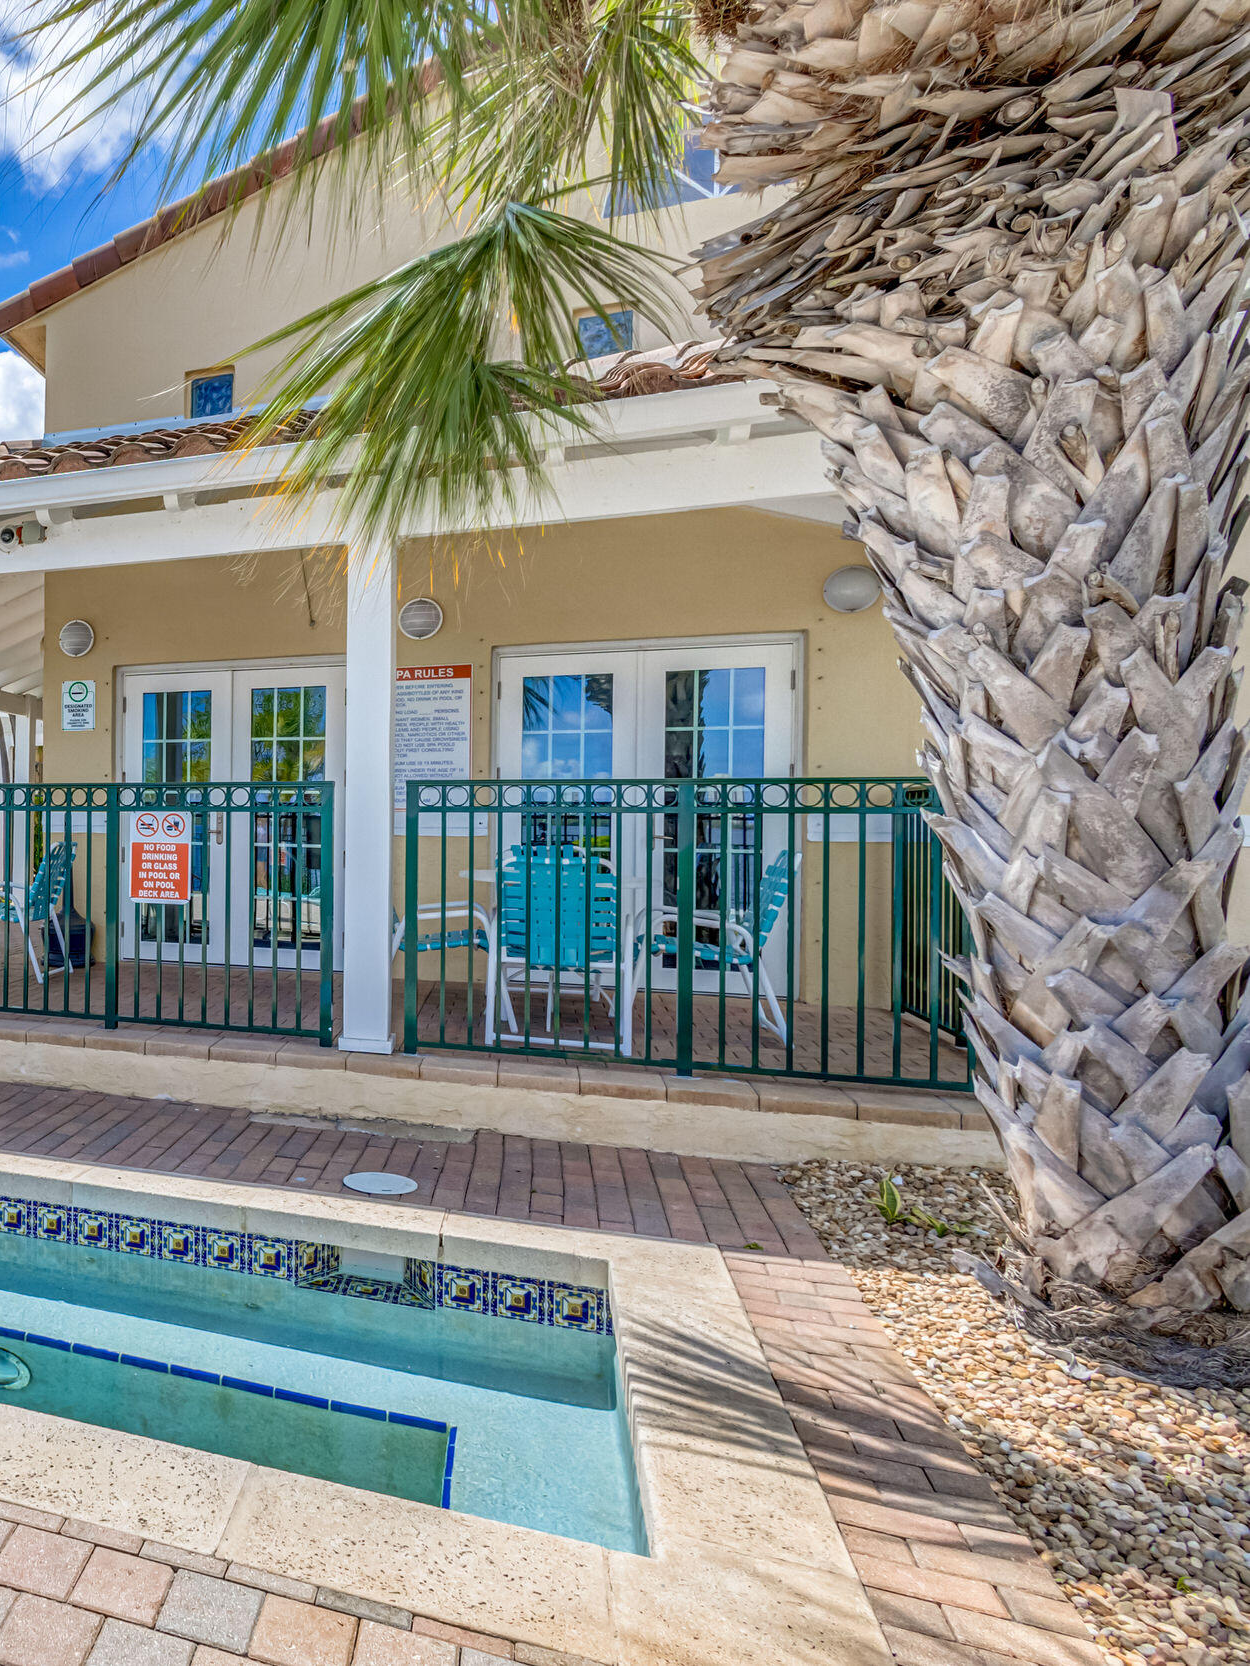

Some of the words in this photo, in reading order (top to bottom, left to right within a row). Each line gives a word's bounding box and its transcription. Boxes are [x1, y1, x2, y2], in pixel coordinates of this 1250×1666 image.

[396, 670, 411, 679] PA
[414, 668, 453, 678] RULES
[142, 852, 178, 860] DRINKING
